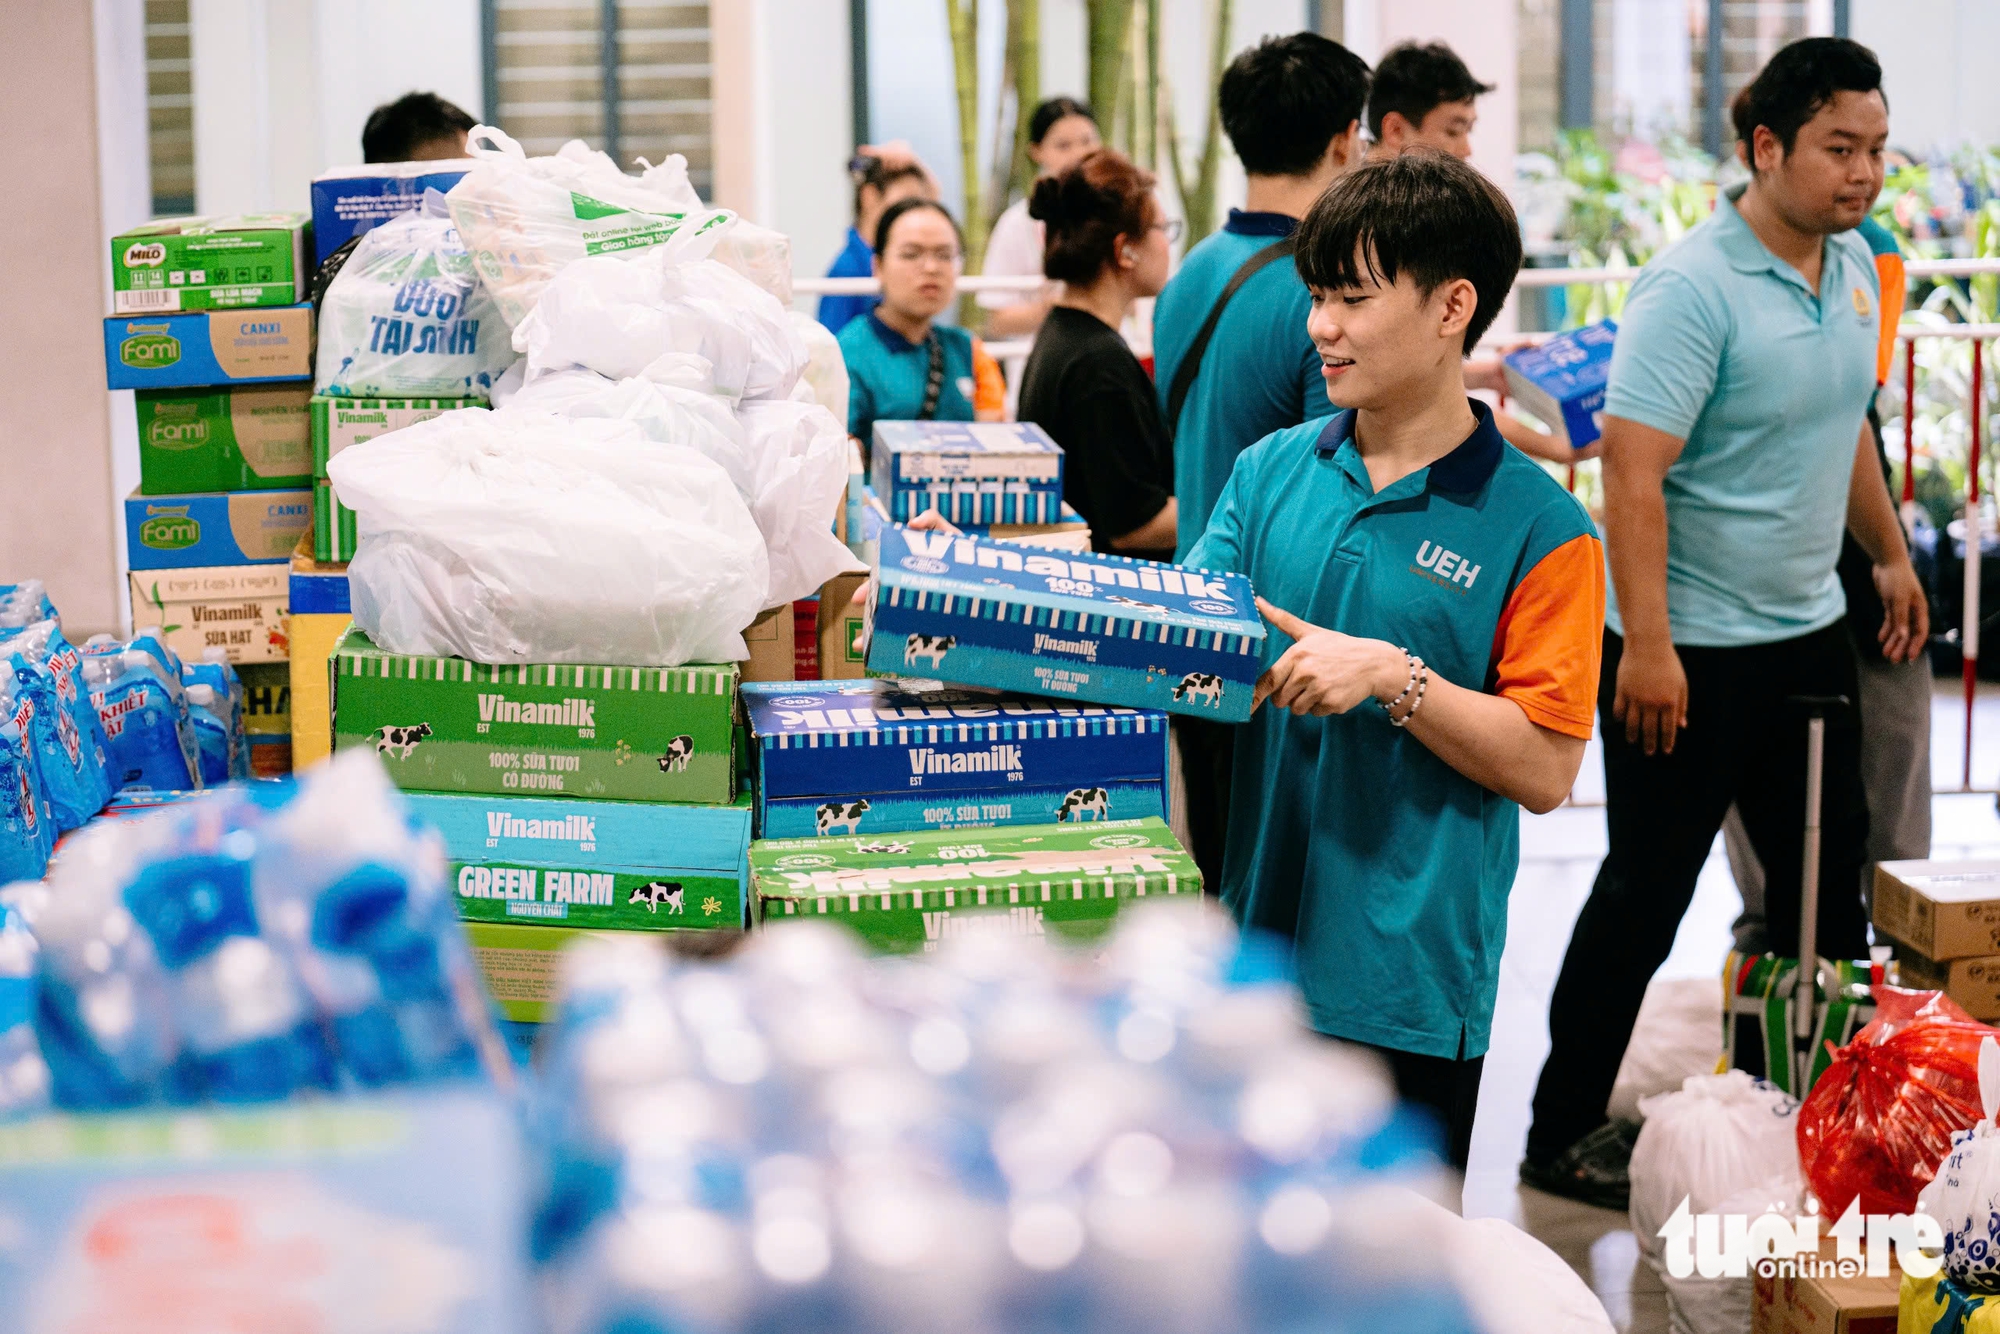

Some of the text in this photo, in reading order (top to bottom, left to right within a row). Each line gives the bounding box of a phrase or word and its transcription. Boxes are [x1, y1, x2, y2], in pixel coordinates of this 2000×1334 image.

[601, 228, 629, 237] online
[601, 241, 626, 251] Giao
[627, 235, 654, 247] hàng
[131, 249, 160, 260] MILO
[337, 411, 388, 424] Vinamilk
[901, 529, 1235, 602] Vinamilk
[1416, 540, 1481, 588] UEH
[1045, 577, 1103, 594] 100%
[192, 603, 263, 622] Vinamilk
[1034, 633, 1098, 656] Vinamilk
[1034, 667, 1053, 680] 100%
[478, 694, 596, 727] Vinamilk
[476, 723, 490, 734] EST
[578, 728, 596, 739] 1976
[489, 751, 580, 772] 100% SỮA TƯƠI
[908, 744, 1024, 775] Vinamilk
[502, 770, 564, 790] CÓ ĐƯỜNG
[910, 776, 923, 786] EST
[1007, 771, 1024, 782] 1976
[923, 803, 1012, 823] 100% SỮA TƯƠI
[486, 811, 596, 841] Vinamilk
[486, 838, 499, 848] EST
[580, 842, 596, 852] 1976
[458, 866, 615, 906] GREEN FARM
[511, 901, 541, 915] NGUYÊN
